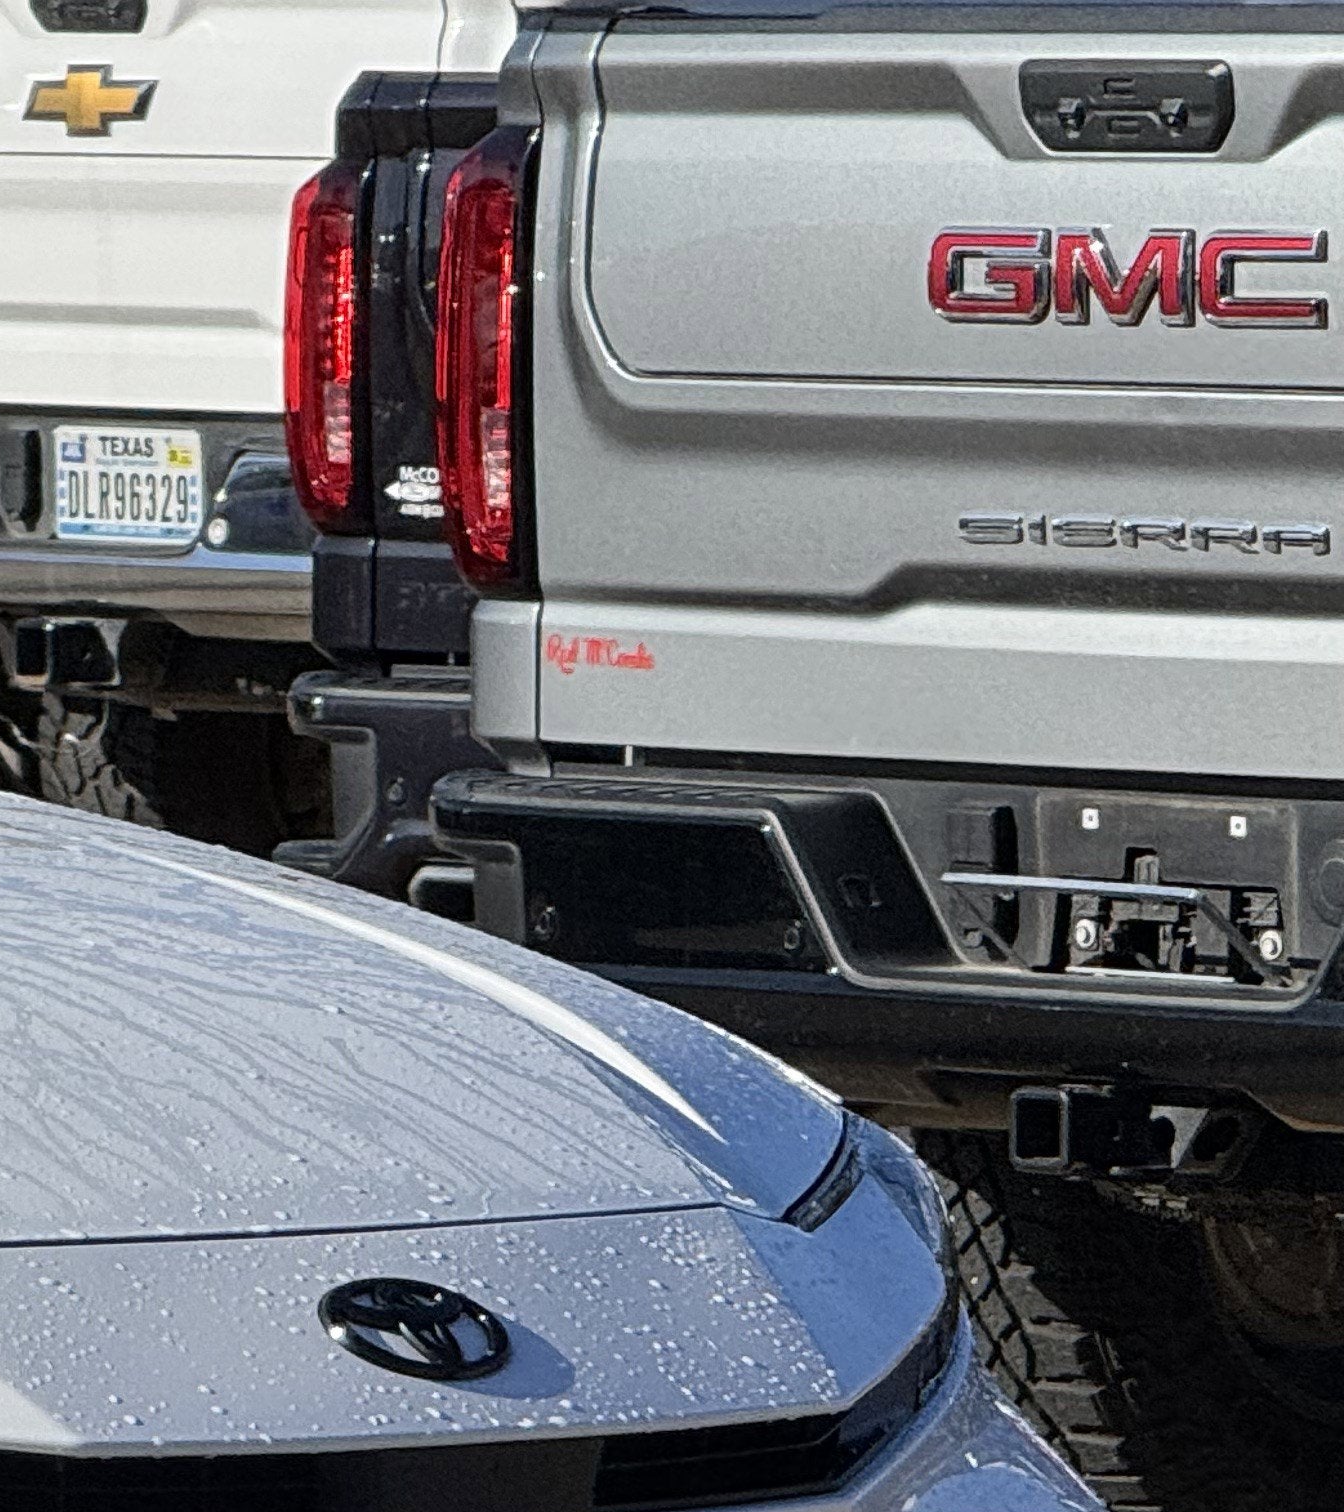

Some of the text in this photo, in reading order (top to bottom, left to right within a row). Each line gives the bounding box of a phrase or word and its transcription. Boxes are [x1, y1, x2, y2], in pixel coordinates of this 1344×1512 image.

[928, 226, 1328, 329] GMC
[98, 435, 154, 458] TEXAS
[68, 470, 189, 523] DLR96329
[958, 512, 1332, 556] SIERRA
